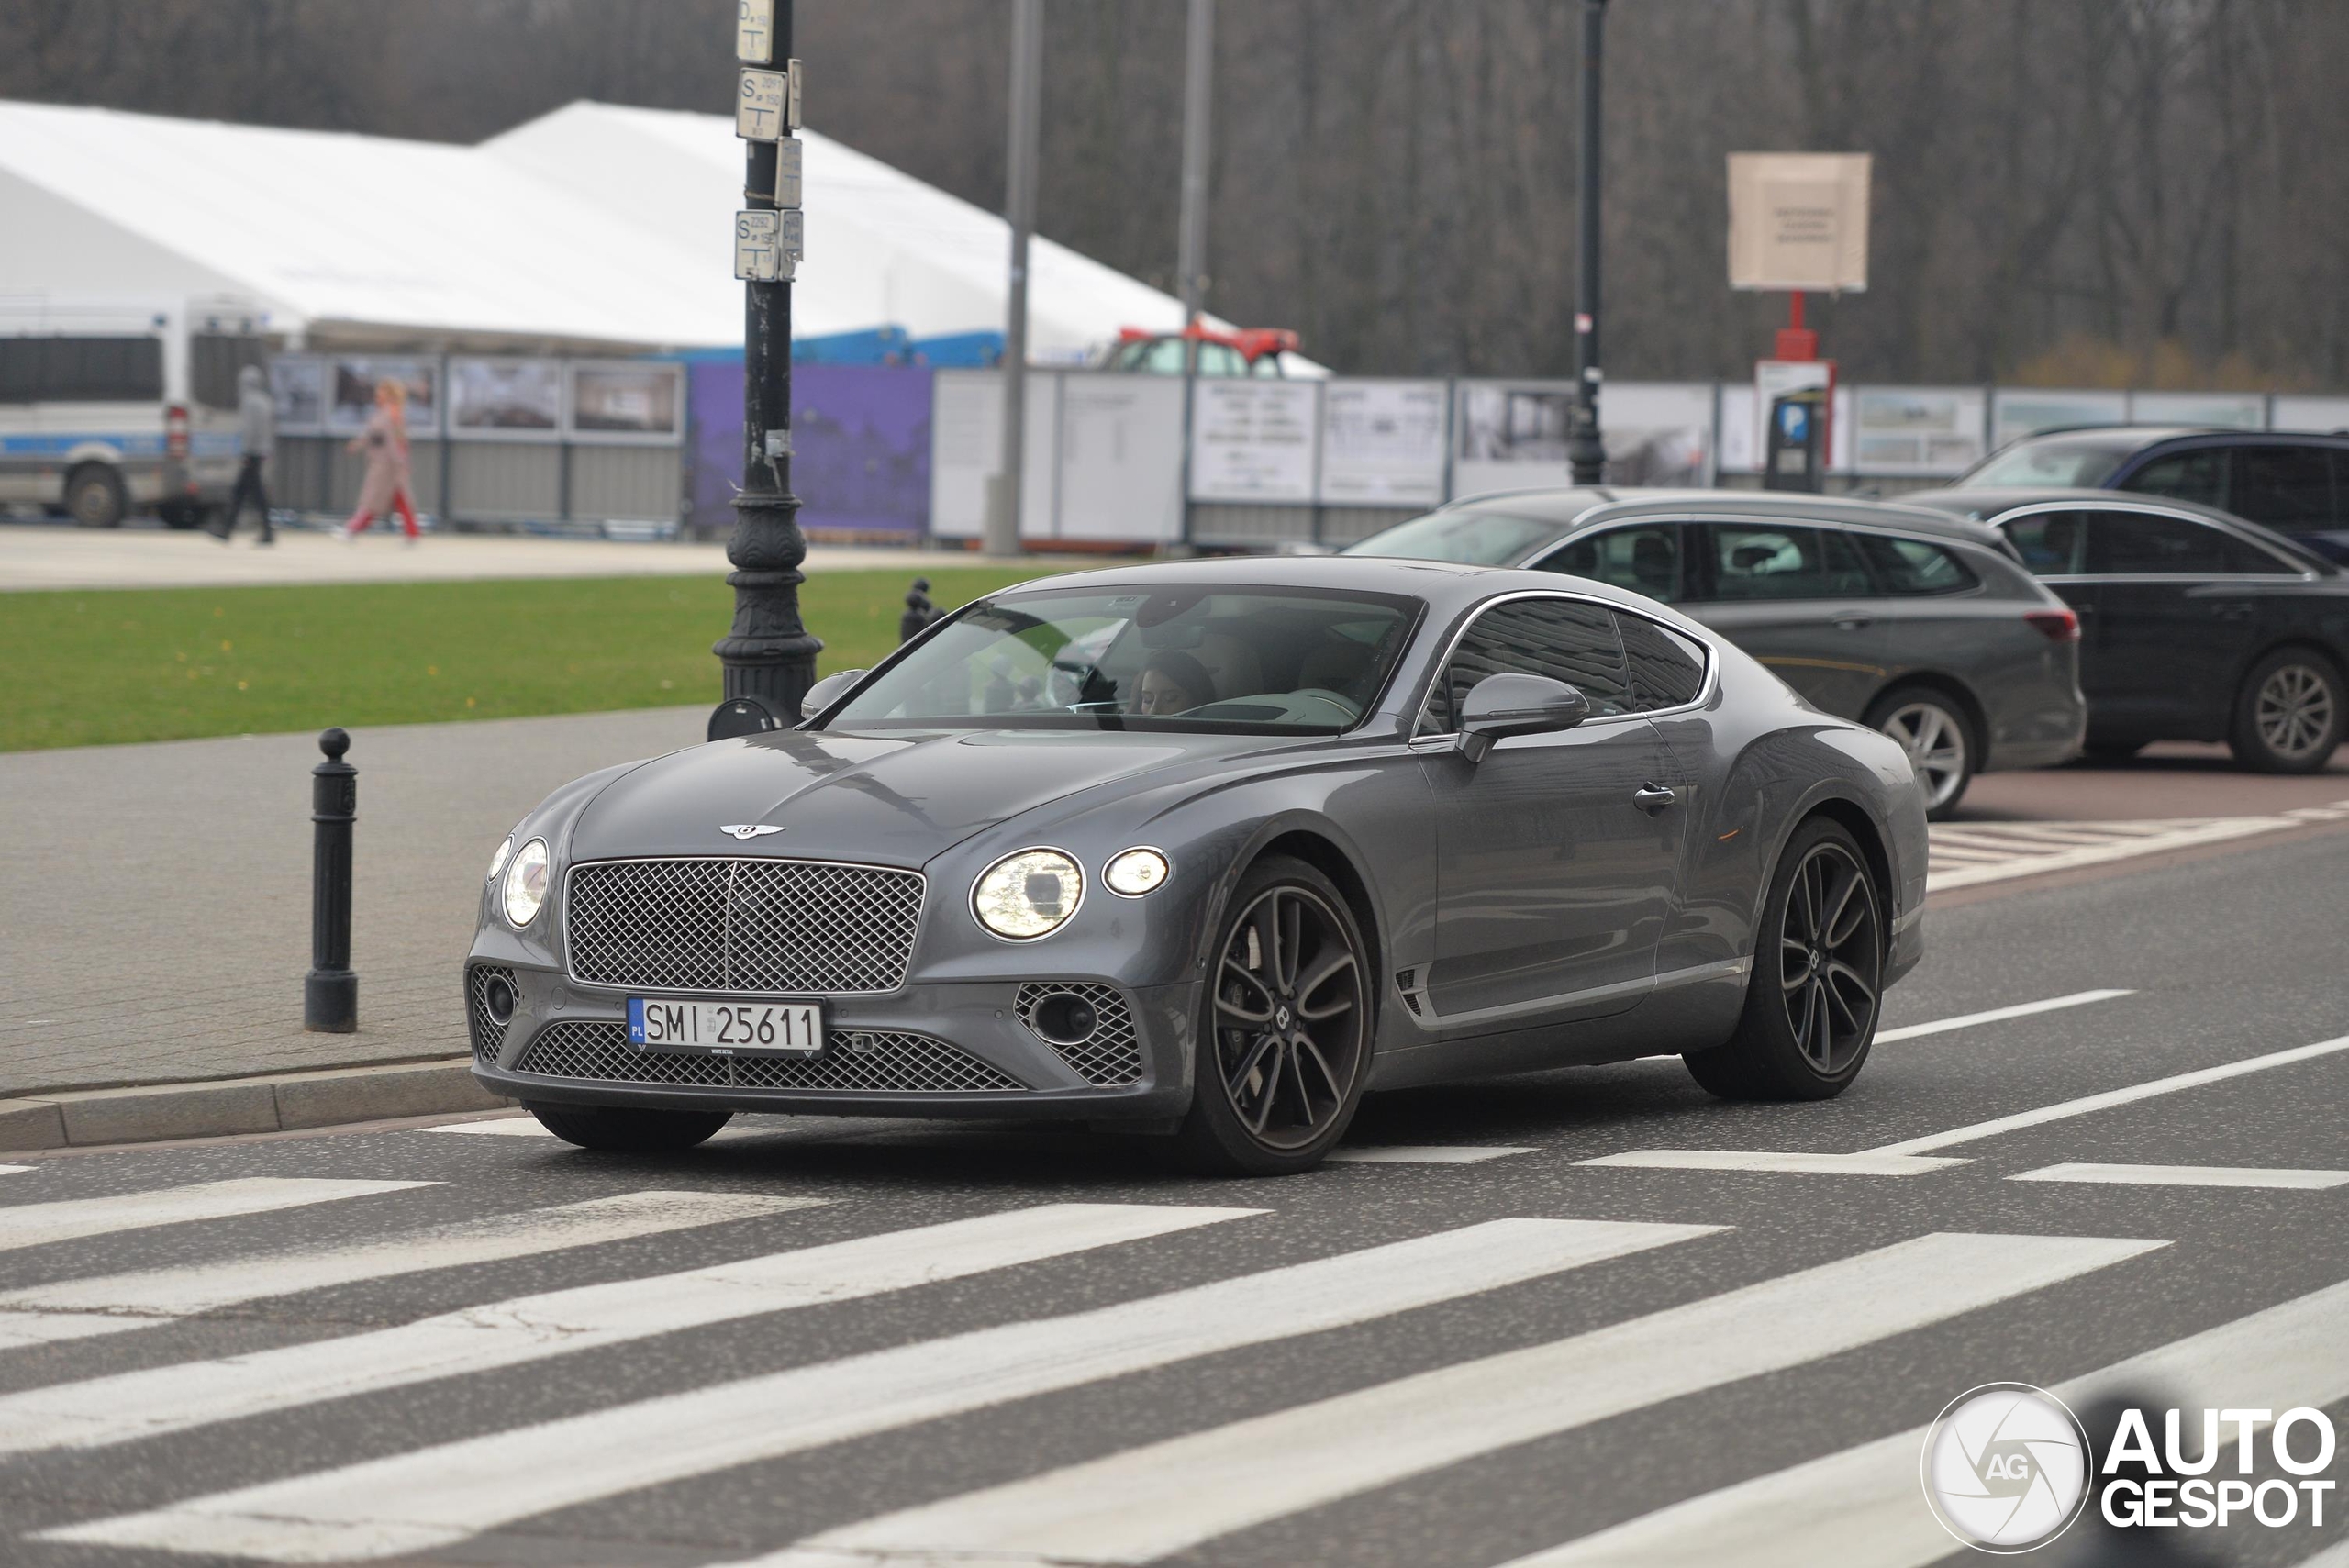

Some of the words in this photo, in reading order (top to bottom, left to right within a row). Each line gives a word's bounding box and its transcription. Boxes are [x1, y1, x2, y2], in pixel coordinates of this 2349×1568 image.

[742, 79, 755, 97] S
[738, 219, 750, 239] S
[631, 1026, 643, 1037] PL
[646, 1004, 698, 1042] SMI
[716, 1006, 813, 1046] 25611
